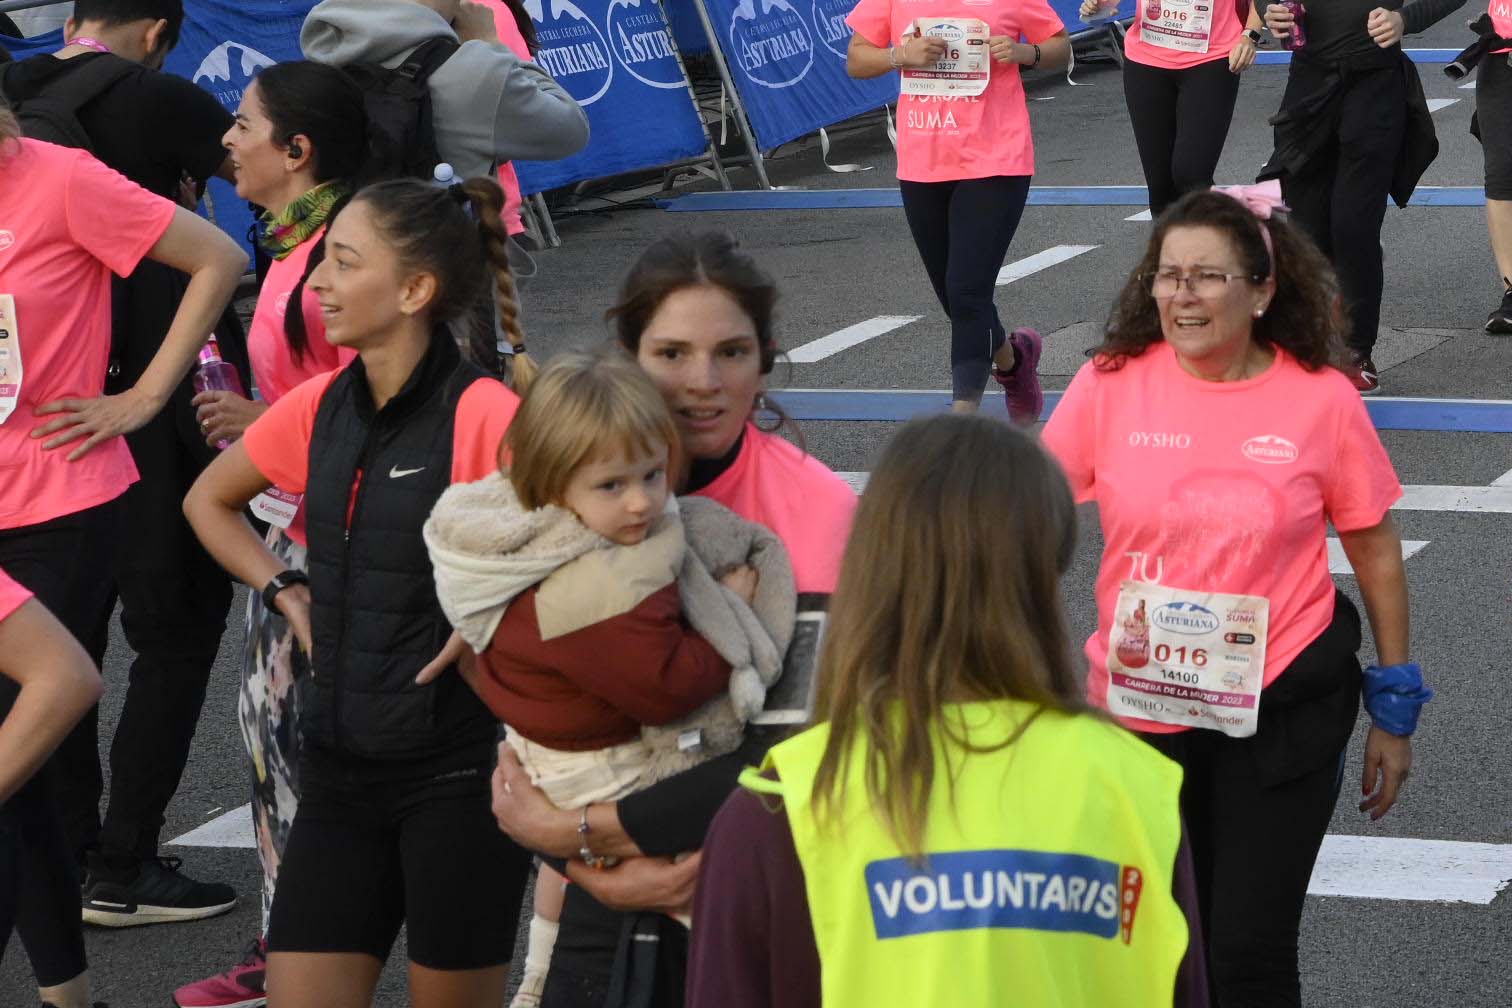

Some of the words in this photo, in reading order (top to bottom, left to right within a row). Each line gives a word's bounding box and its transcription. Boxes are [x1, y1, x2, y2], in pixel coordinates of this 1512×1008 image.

[1163, 9, 1187, 21] 016
[535, 30, 561, 42] ENTRAL
[538, 41, 608, 79] STURIANA
[738, 28, 811, 73] ASTURIANA
[942, 48, 960, 60] 16
[907, 110, 958, 129] SUMA
[1128, 431, 1192, 449] OYSHO
[1124, 551, 1165, 584] TU
[1157, 611, 1215, 630] ASTURIANA
[1226, 613, 1257, 624] SUMA
[1153, 643, 1209, 667] 016
[1160, 668, 1200, 685] 14100
[1124, 677, 1163, 694] CARRERA
[1163, 686, 1175, 696] DE
[1176, 687, 1188, 697] LA
[1189, 689, 1220, 703] MUJER
[1220, 694, 1243, 706] 2023
[1121, 694, 1164, 714] OYSHO
[1199, 708, 1244, 727] Santander
[874, 870, 1118, 920] VOLUNTARIS
